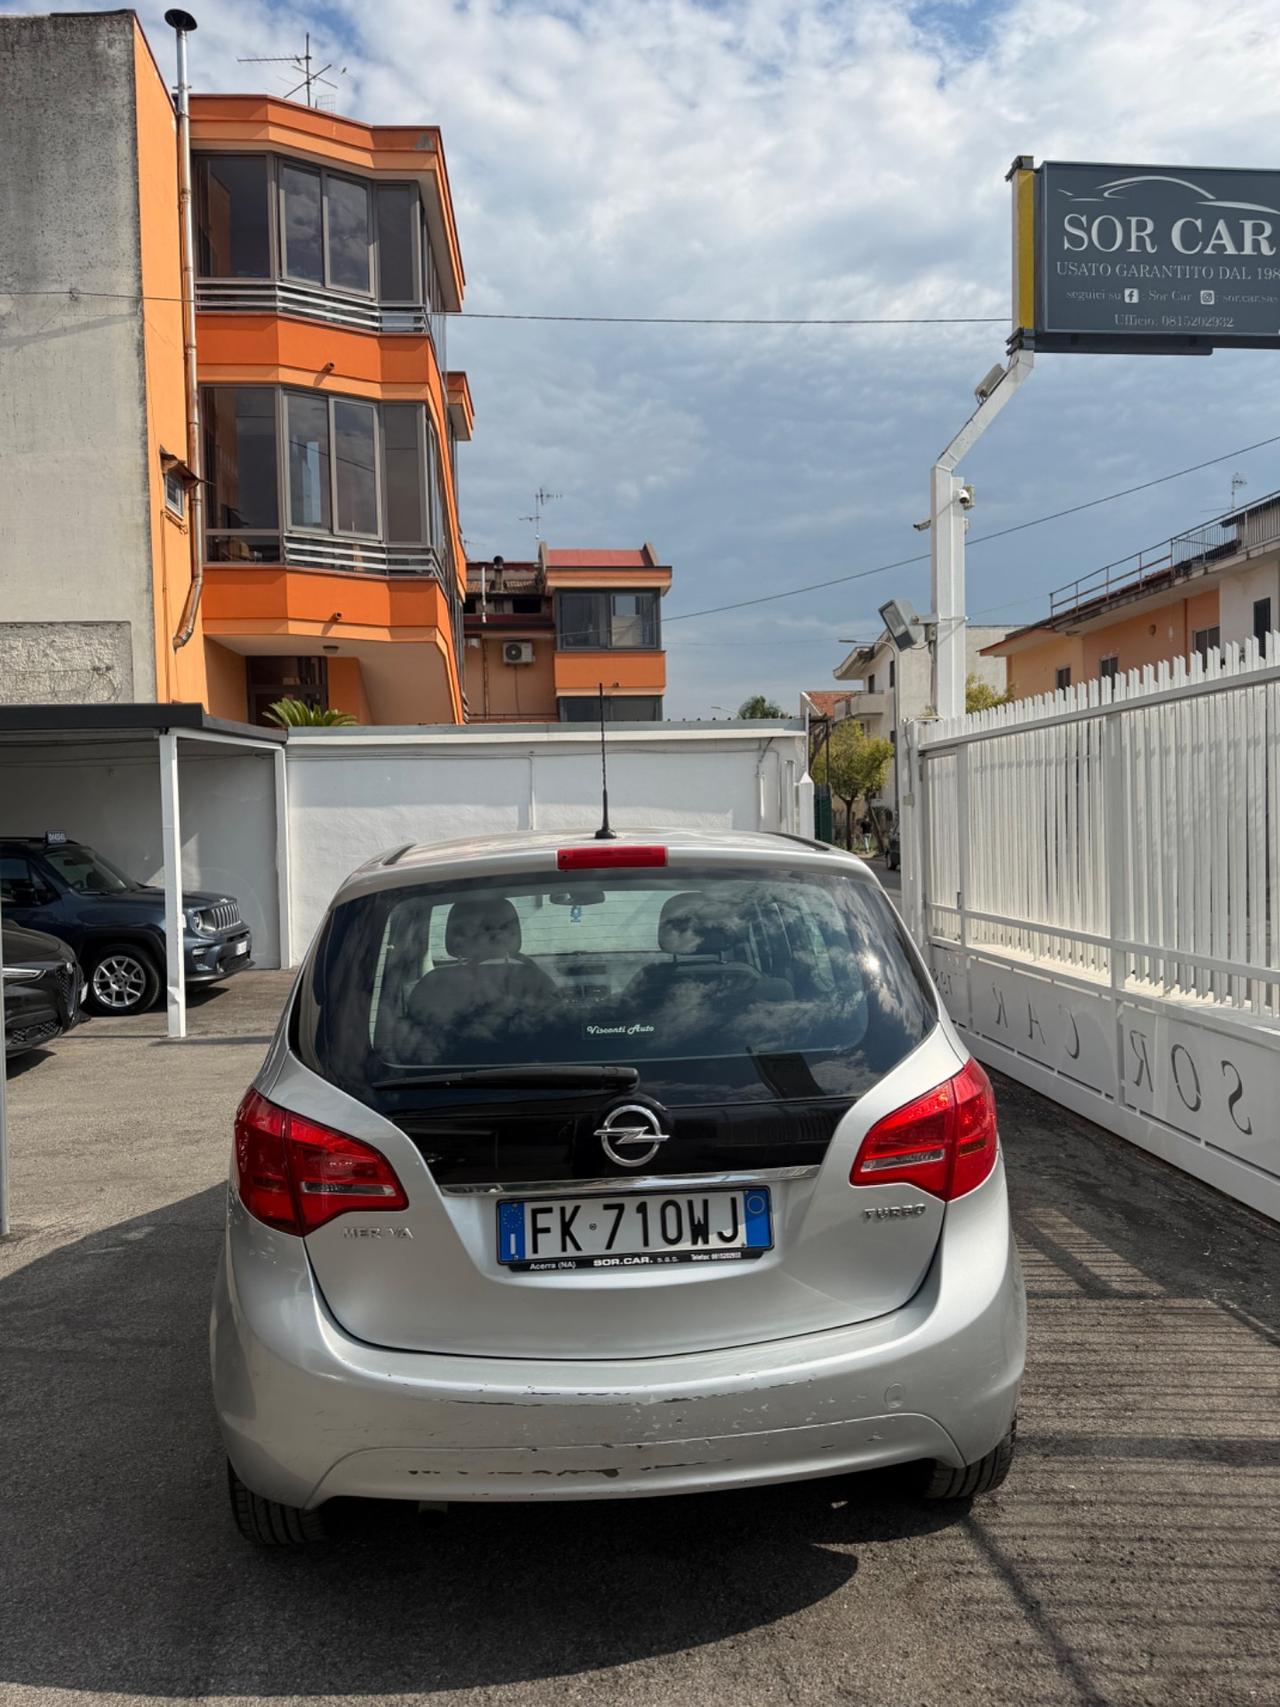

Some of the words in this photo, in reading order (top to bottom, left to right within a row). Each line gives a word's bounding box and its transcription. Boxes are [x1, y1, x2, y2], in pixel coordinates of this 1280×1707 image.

[1063, 213, 1157, 254] SOR
[1171, 217, 1276, 256] CAR
[1056, 261, 1111, 276] USATO
[1115, 263, 1214, 280] GARANTITO
[1219, 266, 1251, 280] DAL
[1148, 289, 1168, 301] Sor
[1171, 290, 1192, 301] Car
[627, 1024, 655, 1035] Auto
[864, 1203, 926, 1219] TURBO
[343, 1227, 414, 1239] MERVA
[531, 1205, 582, 1254] FK
[602, 1197, 738, 1250] 710WJ
